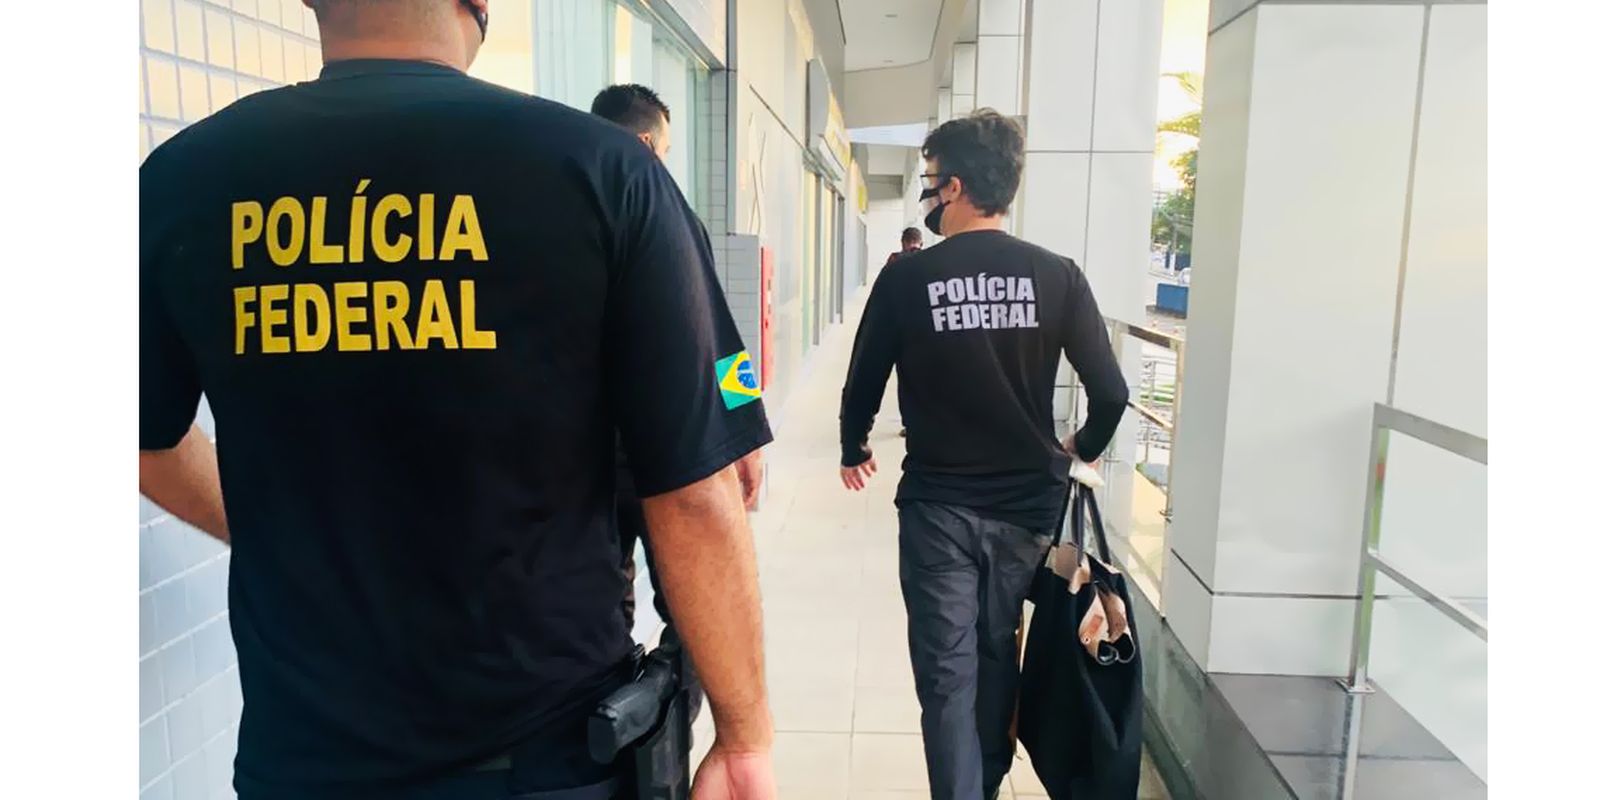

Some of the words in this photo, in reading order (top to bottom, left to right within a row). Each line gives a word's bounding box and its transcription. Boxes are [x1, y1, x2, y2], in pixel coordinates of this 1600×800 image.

[232, 179, 488, 269] POLÍCIA
[928, 272, 1035, 306] POLÍCIA
[234, 280, 497, 354] FEDERAL
[931, 303, 1039, 332] FEDERAL
